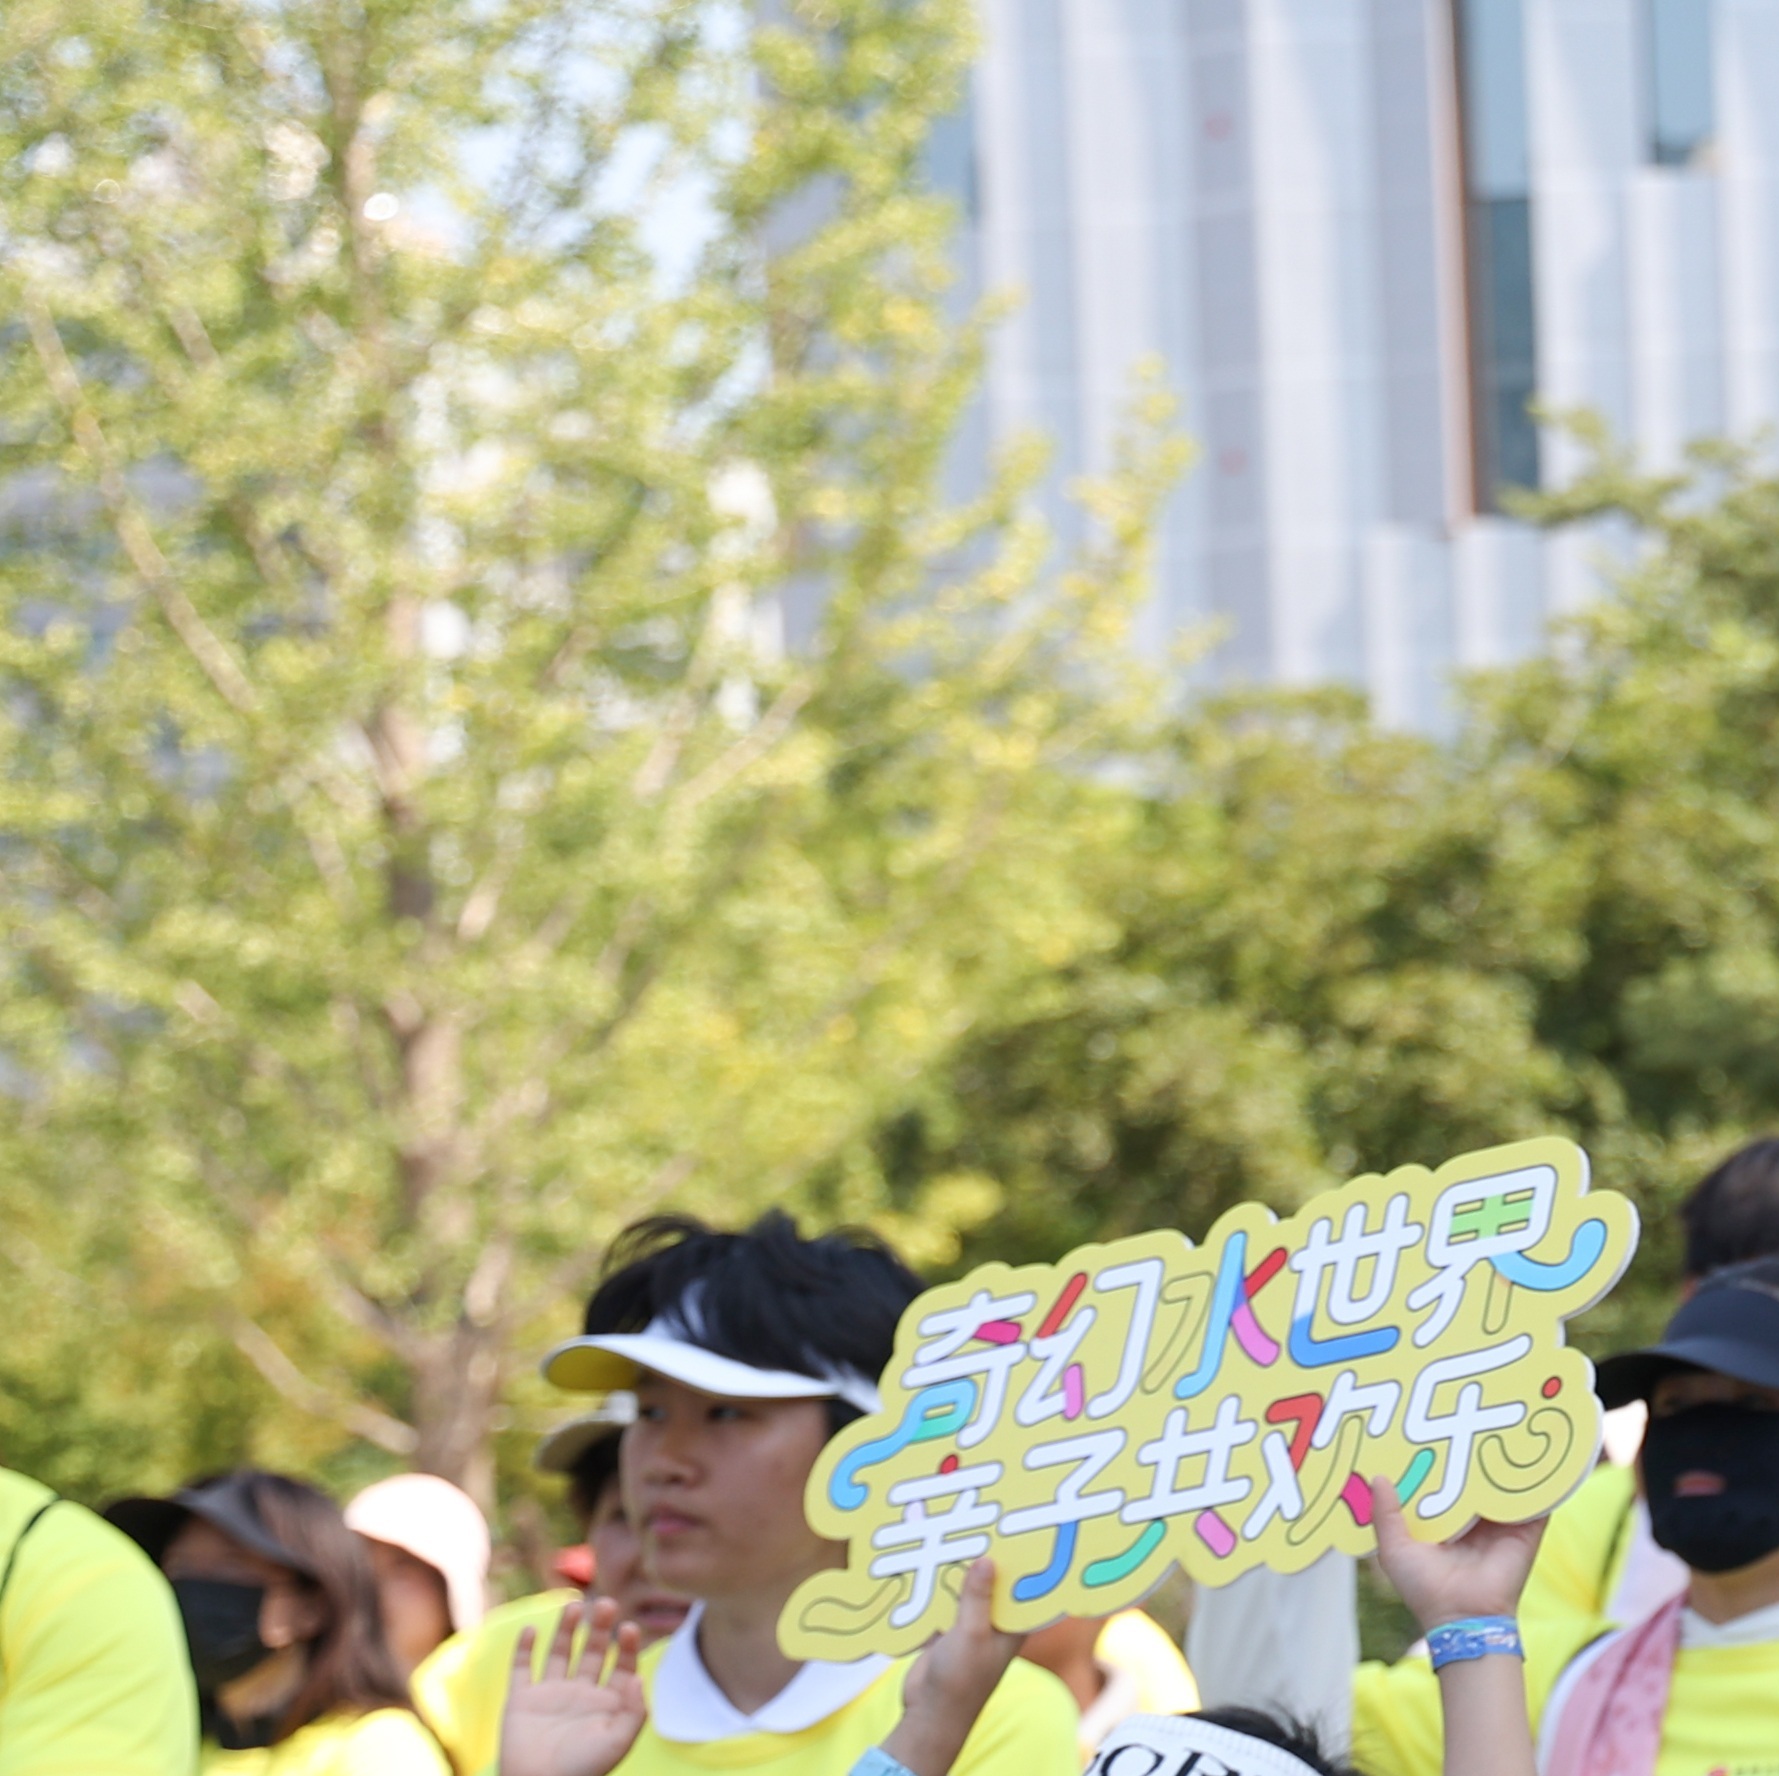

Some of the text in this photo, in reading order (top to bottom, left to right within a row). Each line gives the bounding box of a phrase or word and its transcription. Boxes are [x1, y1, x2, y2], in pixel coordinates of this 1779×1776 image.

[829, 1163, 1608, 1510] 奇幻水世界
[865, 1334, 1573, 1627] 亲子共欢乐
